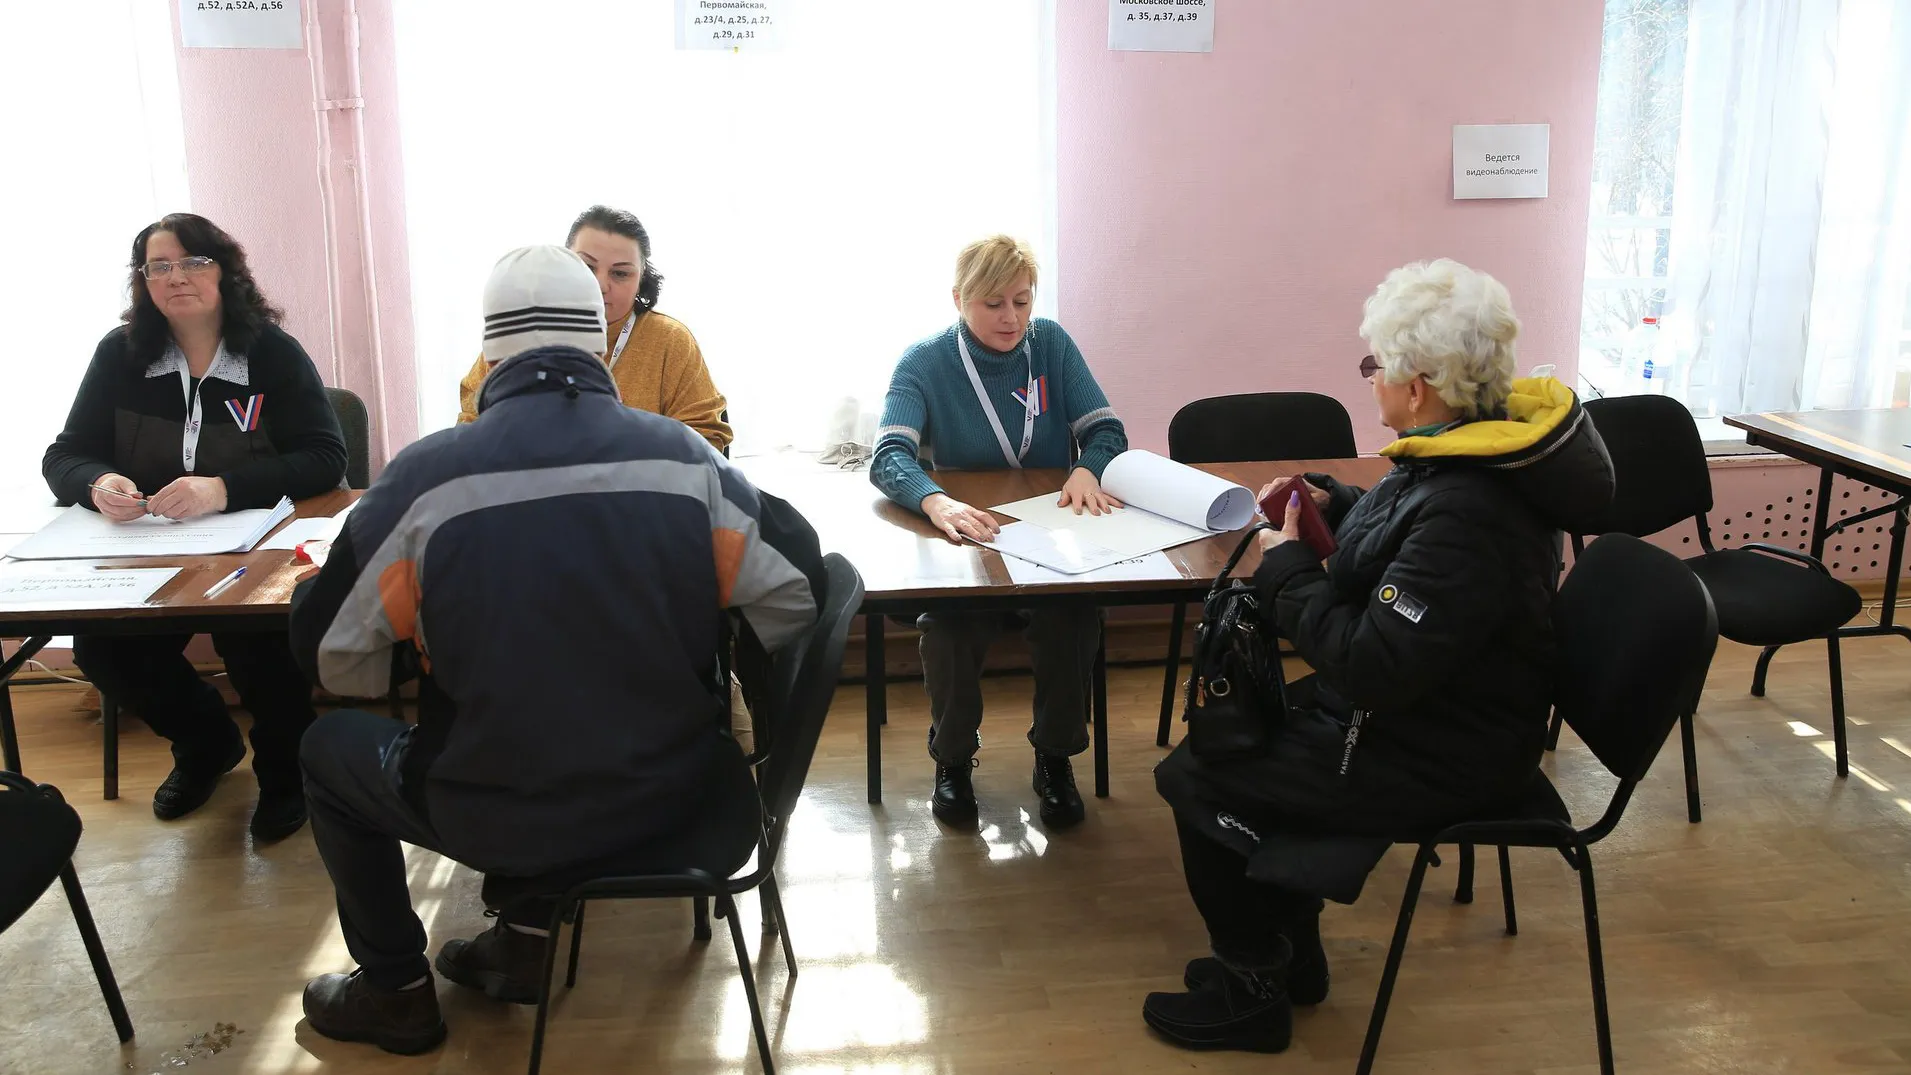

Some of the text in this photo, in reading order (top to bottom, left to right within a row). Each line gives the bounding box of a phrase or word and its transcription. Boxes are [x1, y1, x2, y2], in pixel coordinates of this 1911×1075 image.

[197, 1, 223, 11] д.52,
[260, 1, 283, 11] д.56
[699, 0, 767, 10] Первомайская,
[694, 15, 773, 25] д.23/4, д.25, д.27,
[1153, 12, 1176, 22] д.37,
[1177, 12, 1198, 22] д.39
[712, 30, 755, 40] д.29, д.31
[1485, 153, 1521, 163] Ведется
[1466, 167, 1538, 176] видеонаблюдение
[1339, 742, 1354, 776] FASHION
